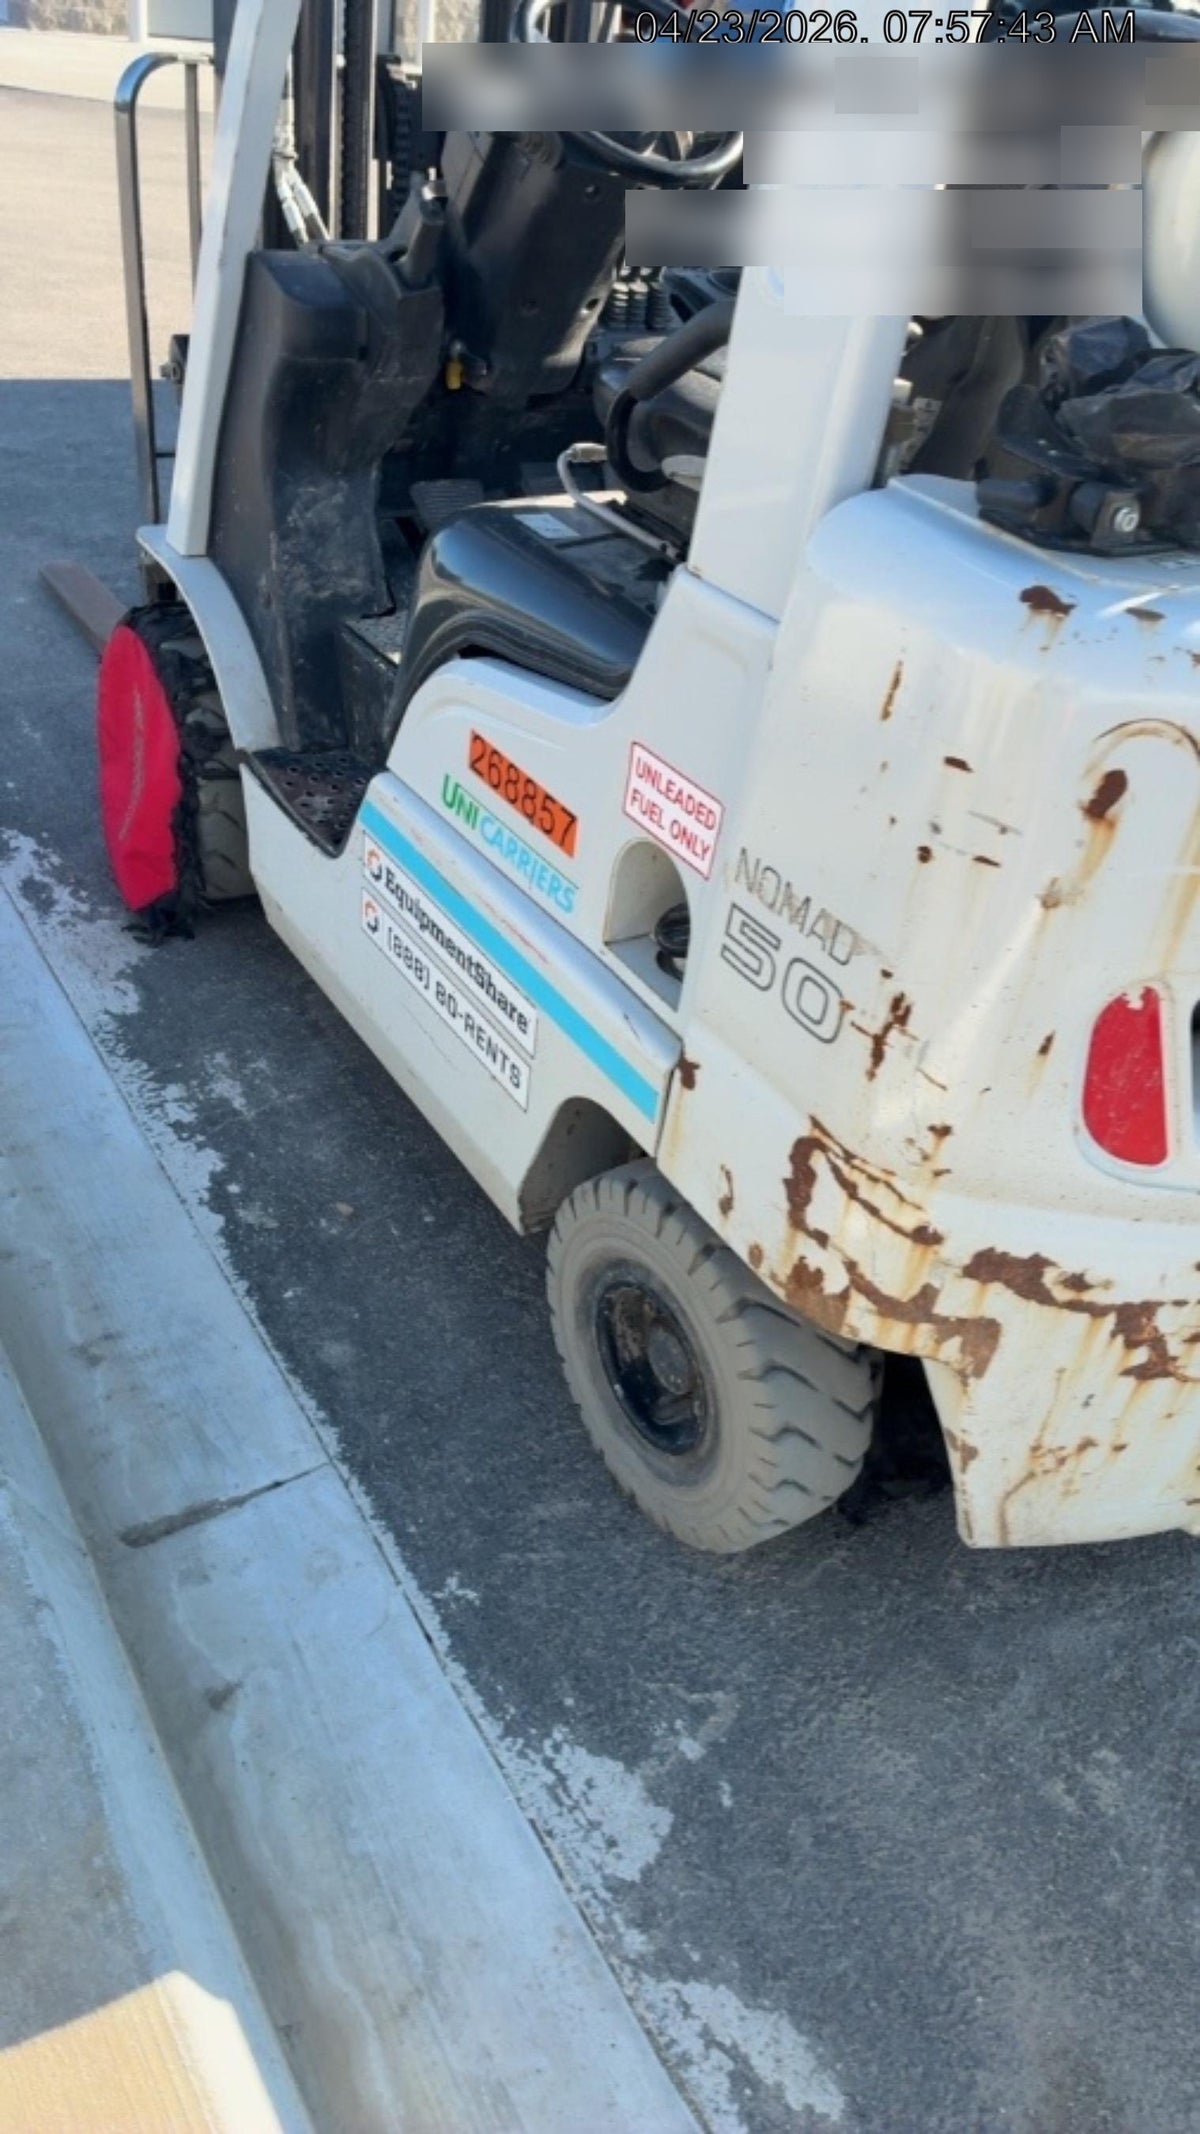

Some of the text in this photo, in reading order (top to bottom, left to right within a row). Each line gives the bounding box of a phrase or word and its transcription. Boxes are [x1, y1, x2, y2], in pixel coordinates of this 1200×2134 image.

[471, 735, 578, 847] 268857
[630, 788, 710, 861] FUEL ONLY
[635, 757, 717, 831] UNLEADED
[384, 867, 530, 1035] EquipmentShare
[734, 846, 857, 966] NOMAD
[387, 927, 521, 1090] (888) 80-RENTS
[720, 902, 845, 1044] 50
